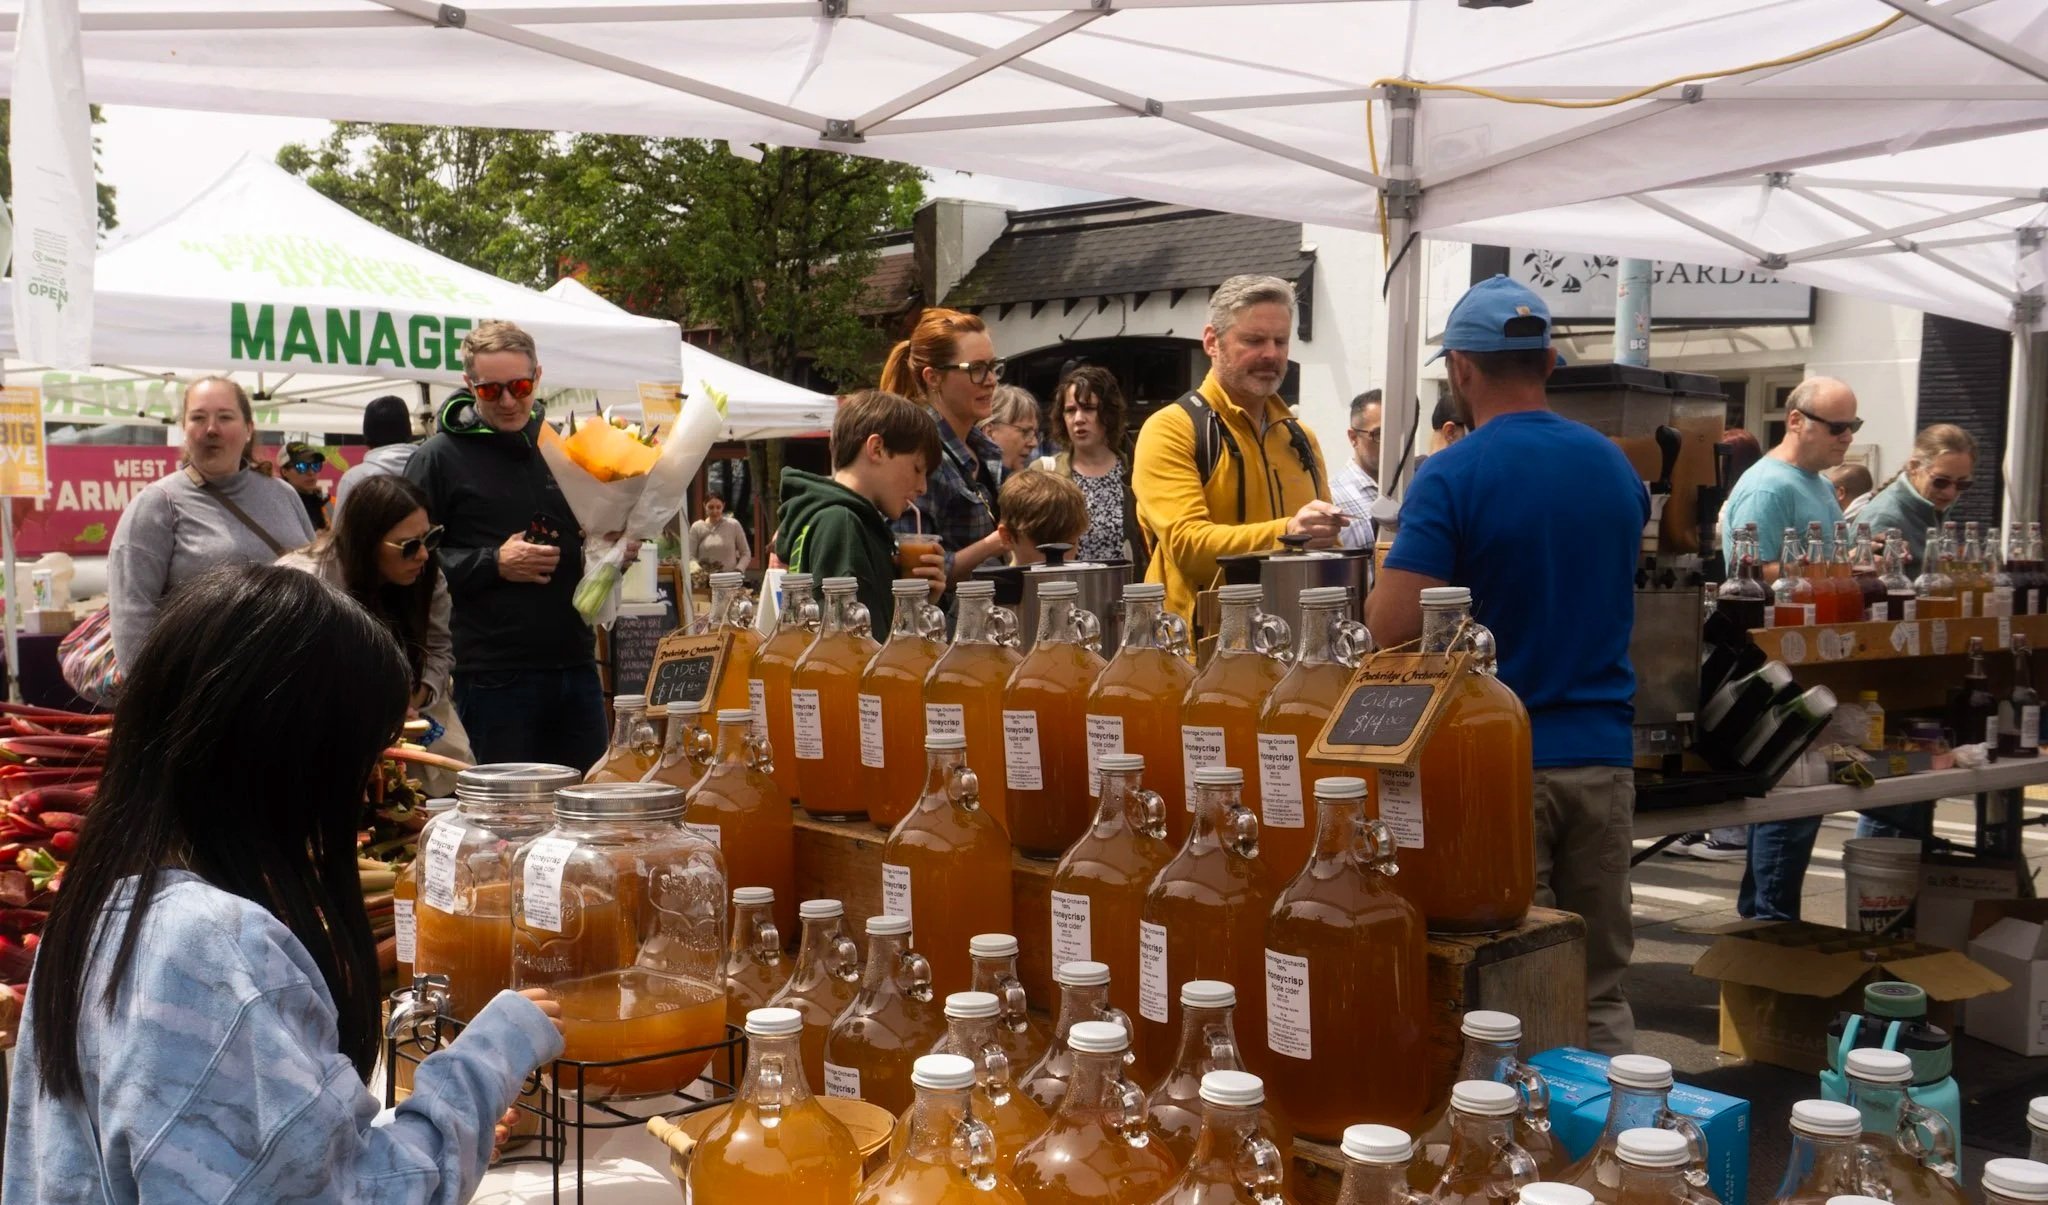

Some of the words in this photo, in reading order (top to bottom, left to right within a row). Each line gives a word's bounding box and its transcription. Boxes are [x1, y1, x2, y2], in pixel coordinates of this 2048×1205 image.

[28, 283, 68, 303] OPEN
[231, 303, 483, 371] MANAGE
[114, 460, 167, 478] WEST
[661, 661, 710, 679] CIDER
[1361, 690, 1415, 709] Cider
[928, 719, 960, 727] Honeycrisp
[1088, 730, 1120, 740] Honeycrisp
[1185, 744, 1221, 753] Honeycrisp
[1260, 752, 1294, 763] Honeycrisp
[530, 854, 562, 865] Honeycrisp
[1053, 910, 1086, 922] Honeycrisp
[1267, 970, 1304, 988] Honeycrisp
[826, 1081, 856, 1095] Honeycrisp
